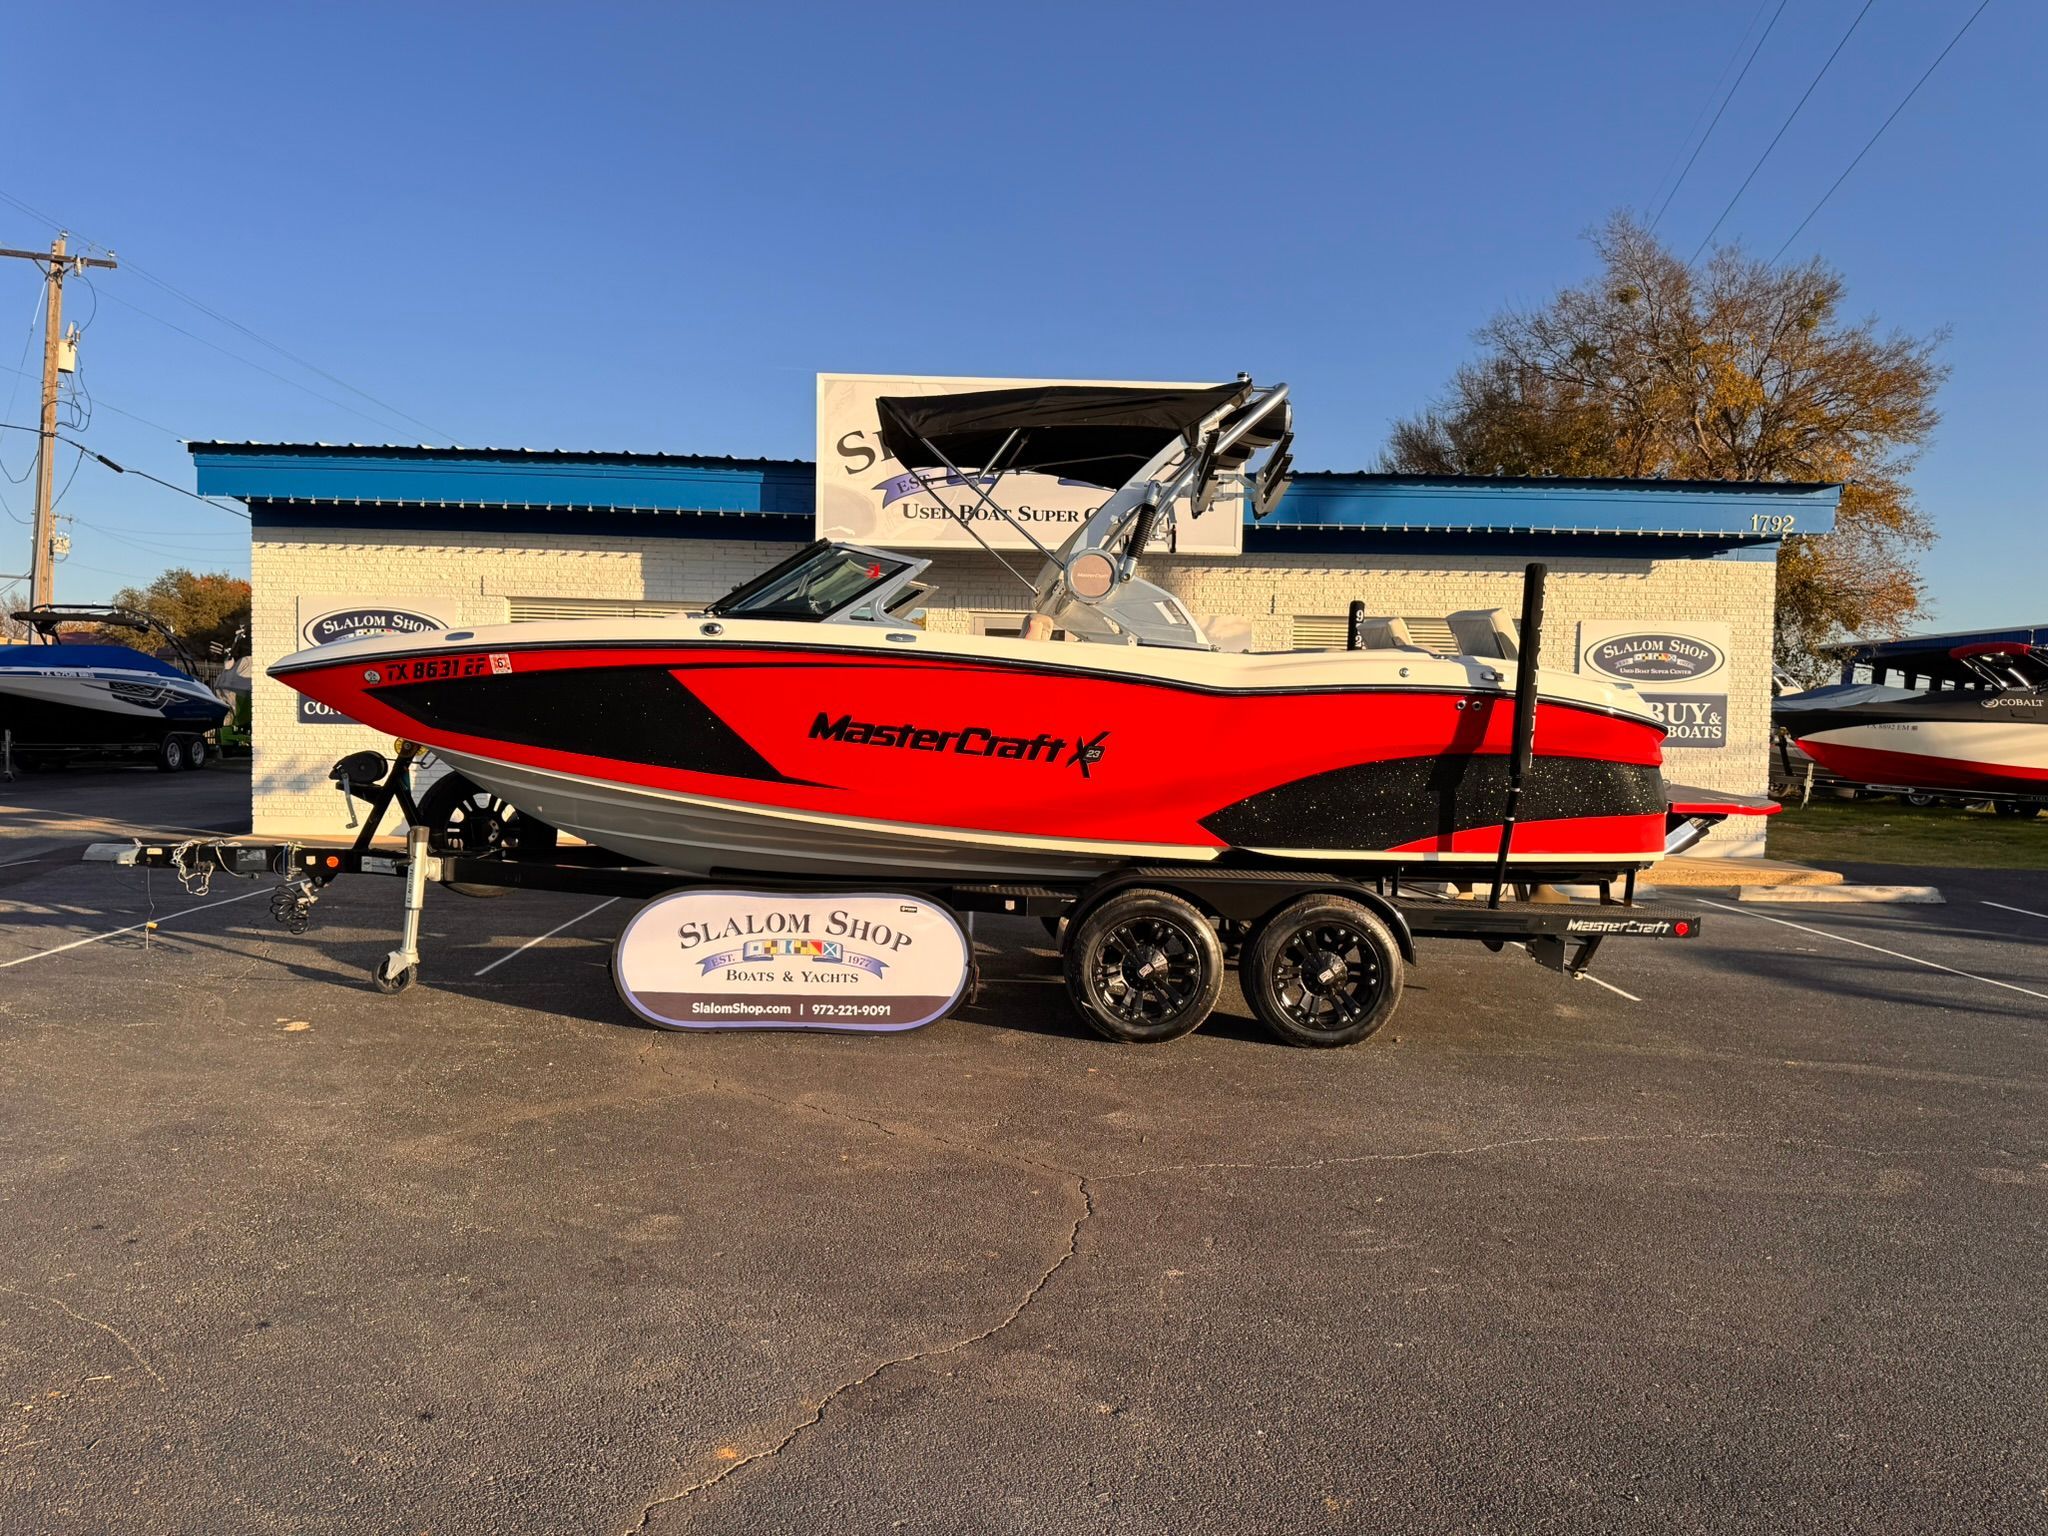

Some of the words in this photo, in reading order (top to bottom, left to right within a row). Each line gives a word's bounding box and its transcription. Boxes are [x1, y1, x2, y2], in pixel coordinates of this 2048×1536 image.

[1018, 505, 1079, 522] SUPER
[1751, 513, 1796, 532] 1792
[322, 615, 386, 635] SLALOM
[1603, 640, 1664, 659] SLALOM
[1669, 639, 1709, 660] SHOP
[385, 663, 408, 681] TX
[413, 660, 460, 680] 8631
[1999, 698, 2044, 707] COBALT
[1708, 711, 1722, 725] &
[808, 712, 1067, 763] MasterCraft
[1667, 726, 1722, 739] BOATS
[677, 912, 811, 950] SLALOM
[825, 910, 913, 952] SHOP
[1566, 918, 1670, 934] MasterCraft
[711, 953, 736, 967] EST.
[847, 955, 872, 968] 1977
[726, 969, 775, 982] BOATS
[782, 970, 794, 982] &
[801, 970, 859, 984] YACHTS
[691, 1002, 792, 1016] SlalomShop.com
[811, 1003, 891, 1017] 972-221-9091
